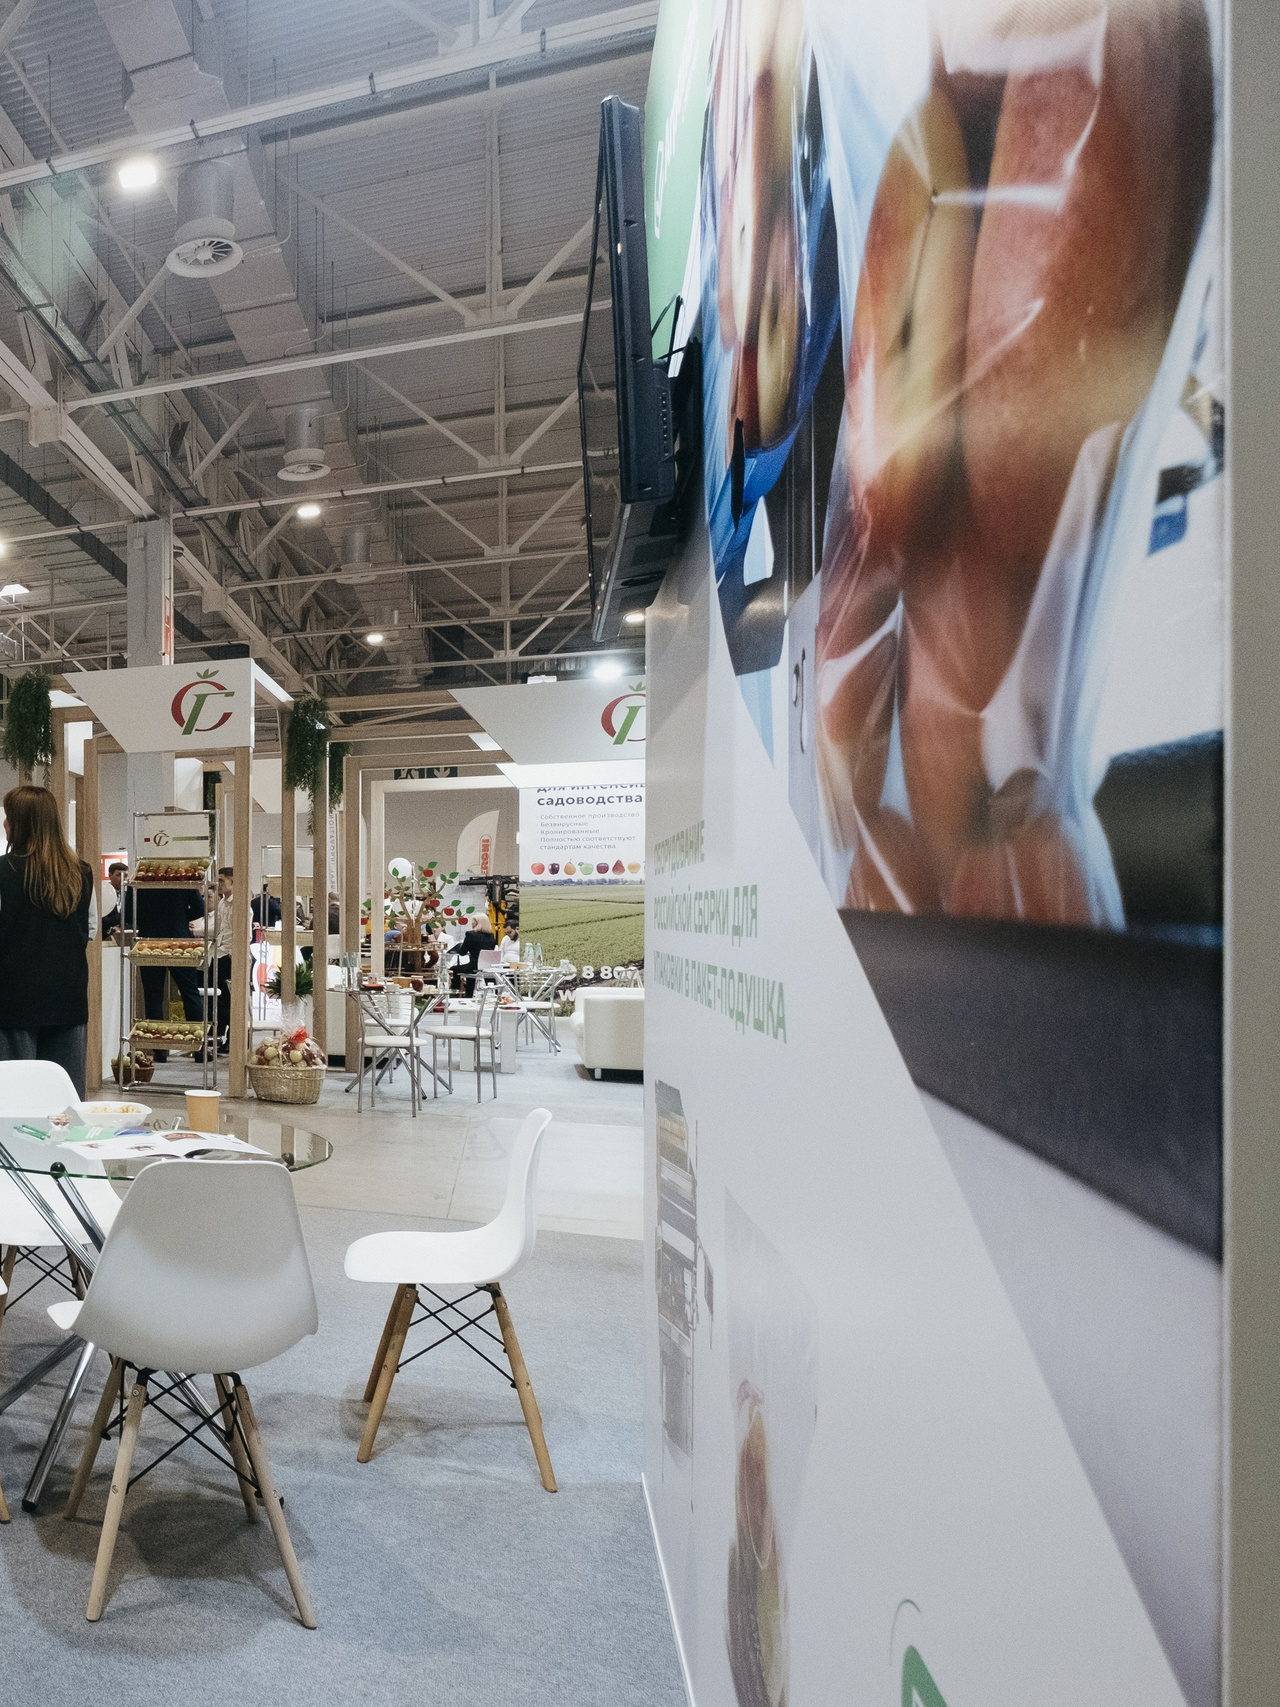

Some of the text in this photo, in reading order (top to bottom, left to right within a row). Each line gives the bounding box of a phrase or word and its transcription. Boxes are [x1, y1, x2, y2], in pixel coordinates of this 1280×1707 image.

[537, 794, 643, 807] садоводства
[588, 811, 640, 819] производство
[540, 821, 589, 829] Безвирусные
[653, 884, 758, 949] РОССИЙСКОЙ СБОРКИ ДЛЯ
[653, 949, 684, 996] УПАКОВКИ
[691, 959, 787, 1045] ПАКЕТ-ПОДУШКА
